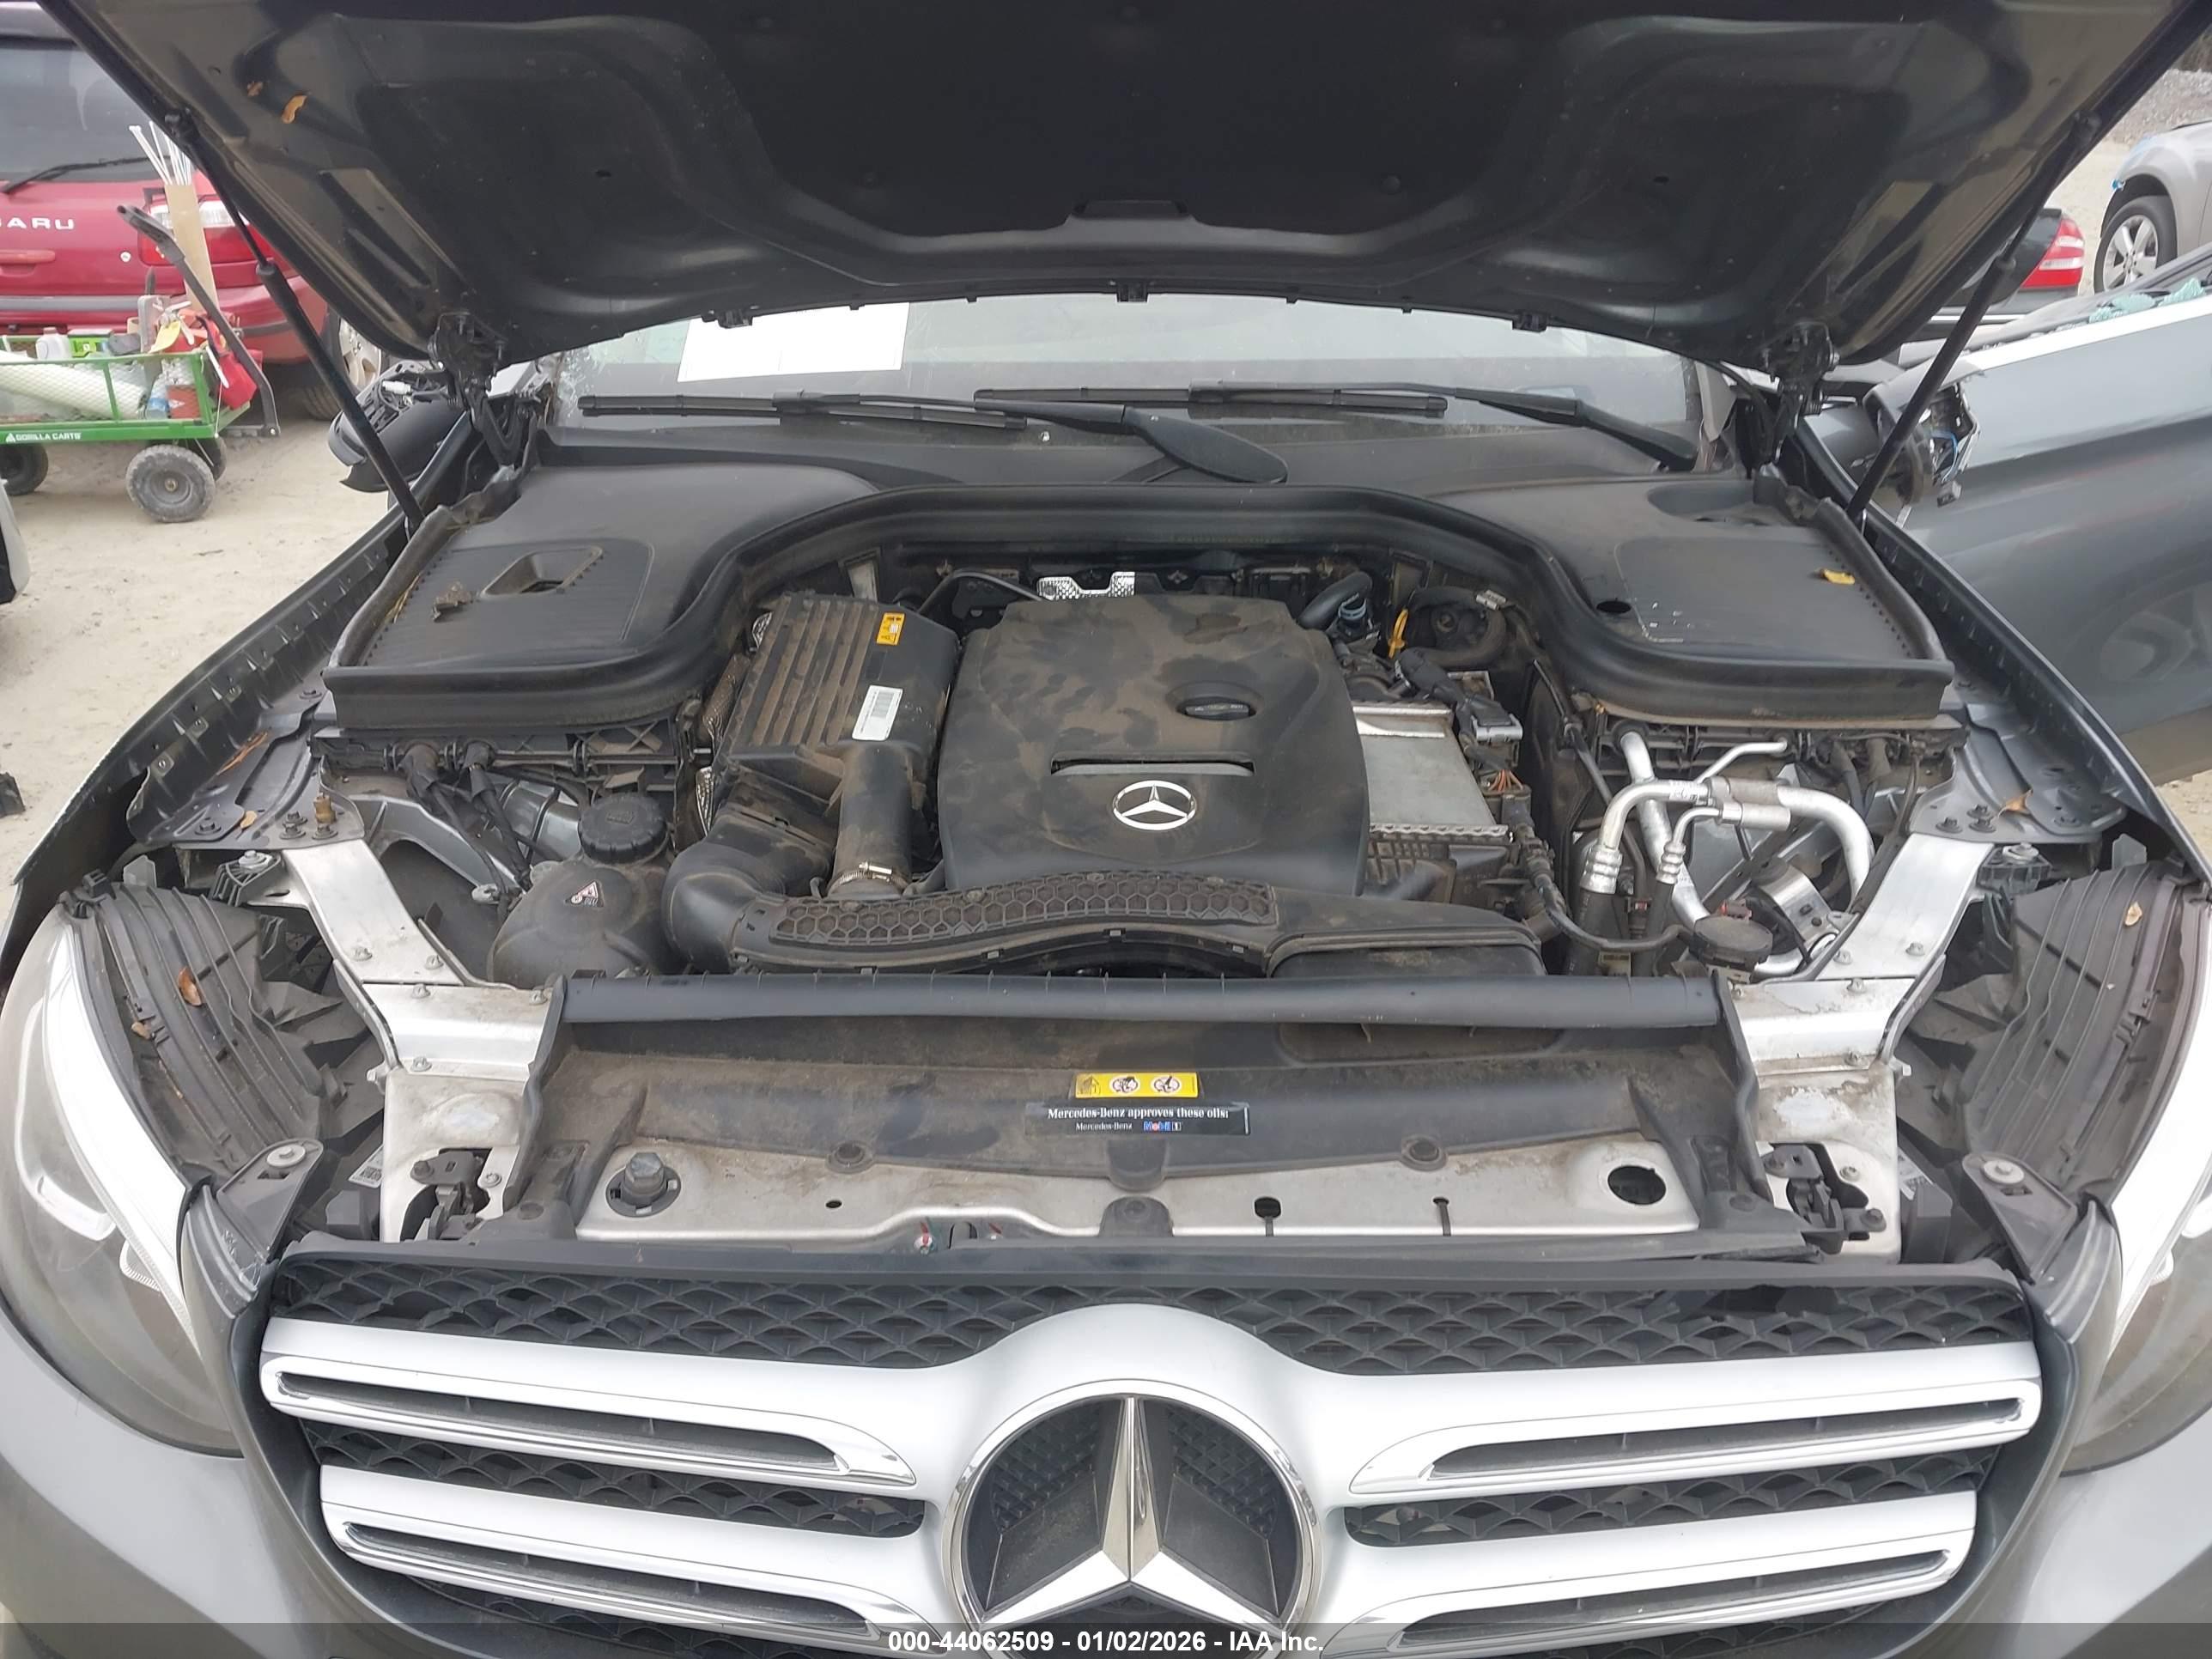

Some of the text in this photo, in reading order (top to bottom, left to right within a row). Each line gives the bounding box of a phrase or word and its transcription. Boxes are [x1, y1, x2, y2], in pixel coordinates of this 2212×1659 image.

[0, 216, 75, 230] ARU
[15, 433, 51, 441] GORILLA
[1048, 1107, 1126, 1119] Mercedes-Benz
[1127, 1108, 1174, 1120] approves
[1176, 1107, 1204, 1118] these
[1075, 1121, 1133, 1131] Mercedes-Benz
[1143, 1121, 1171, 1132] Mobil
